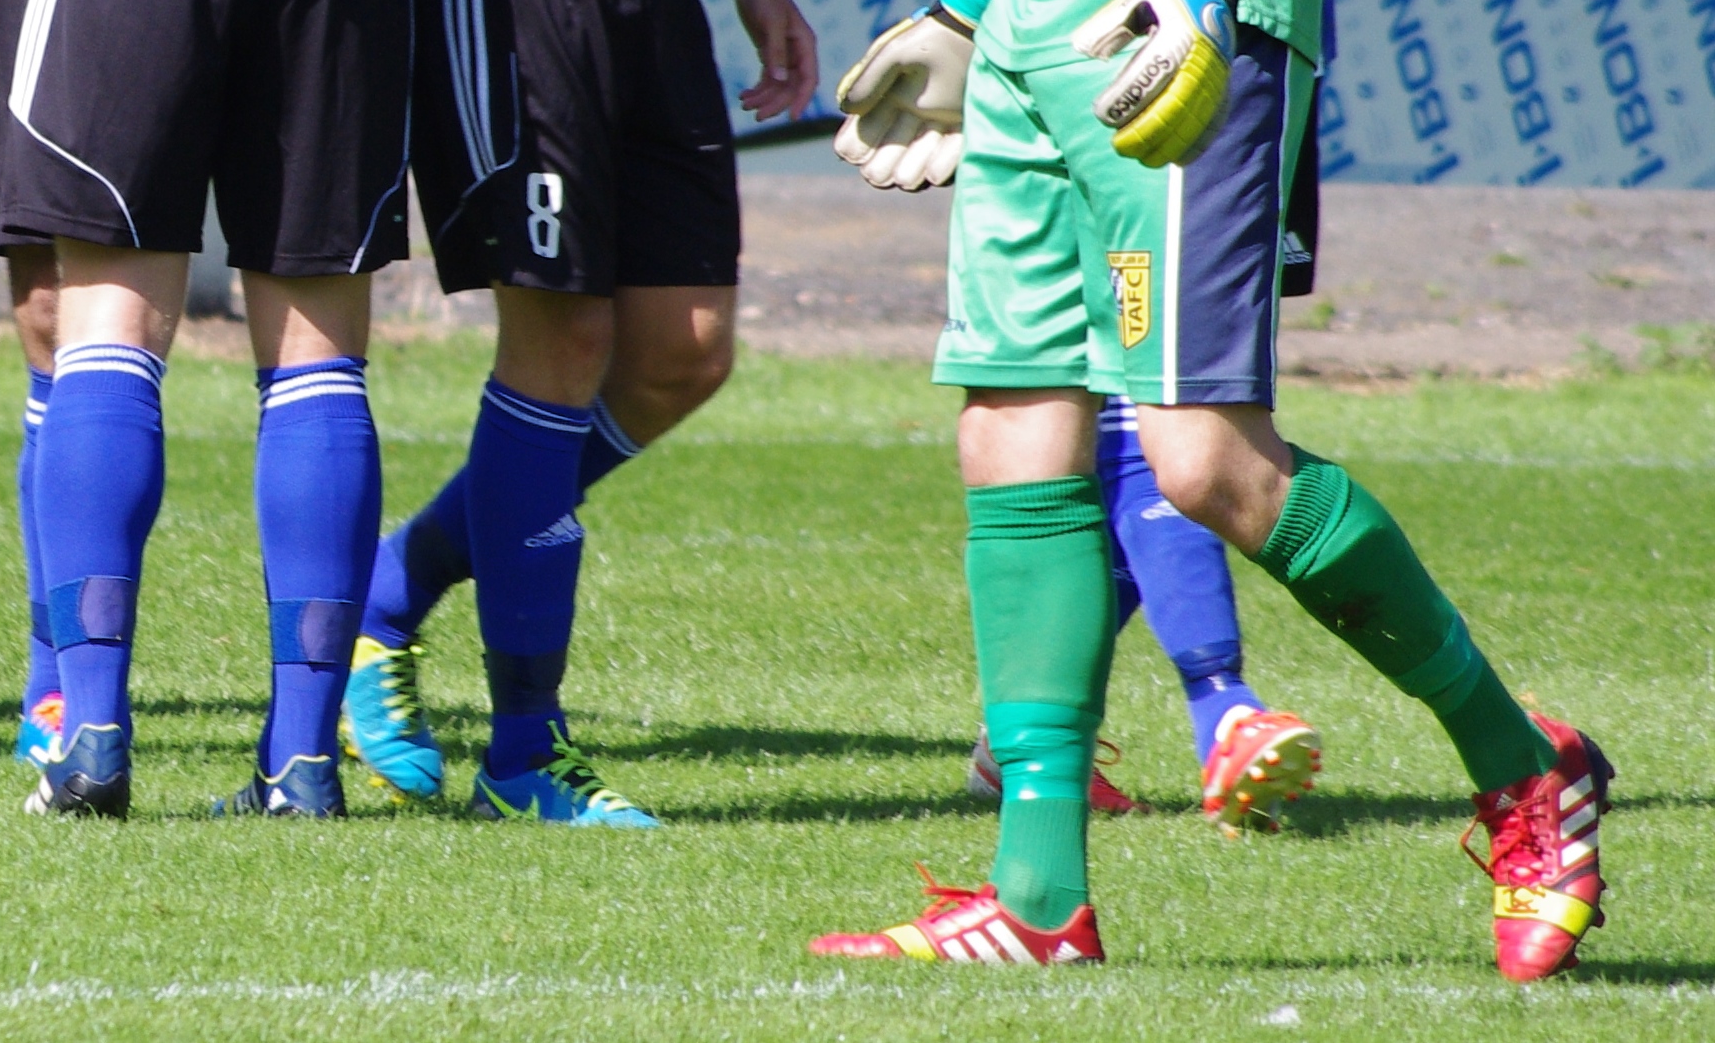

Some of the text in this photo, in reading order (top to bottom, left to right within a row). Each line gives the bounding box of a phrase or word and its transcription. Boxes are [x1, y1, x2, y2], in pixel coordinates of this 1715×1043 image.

[1107, 54, 1170, 121] Sondico
[526, 171, 563, 259] 8
[1126, 271, 1143, 336] TAFC
